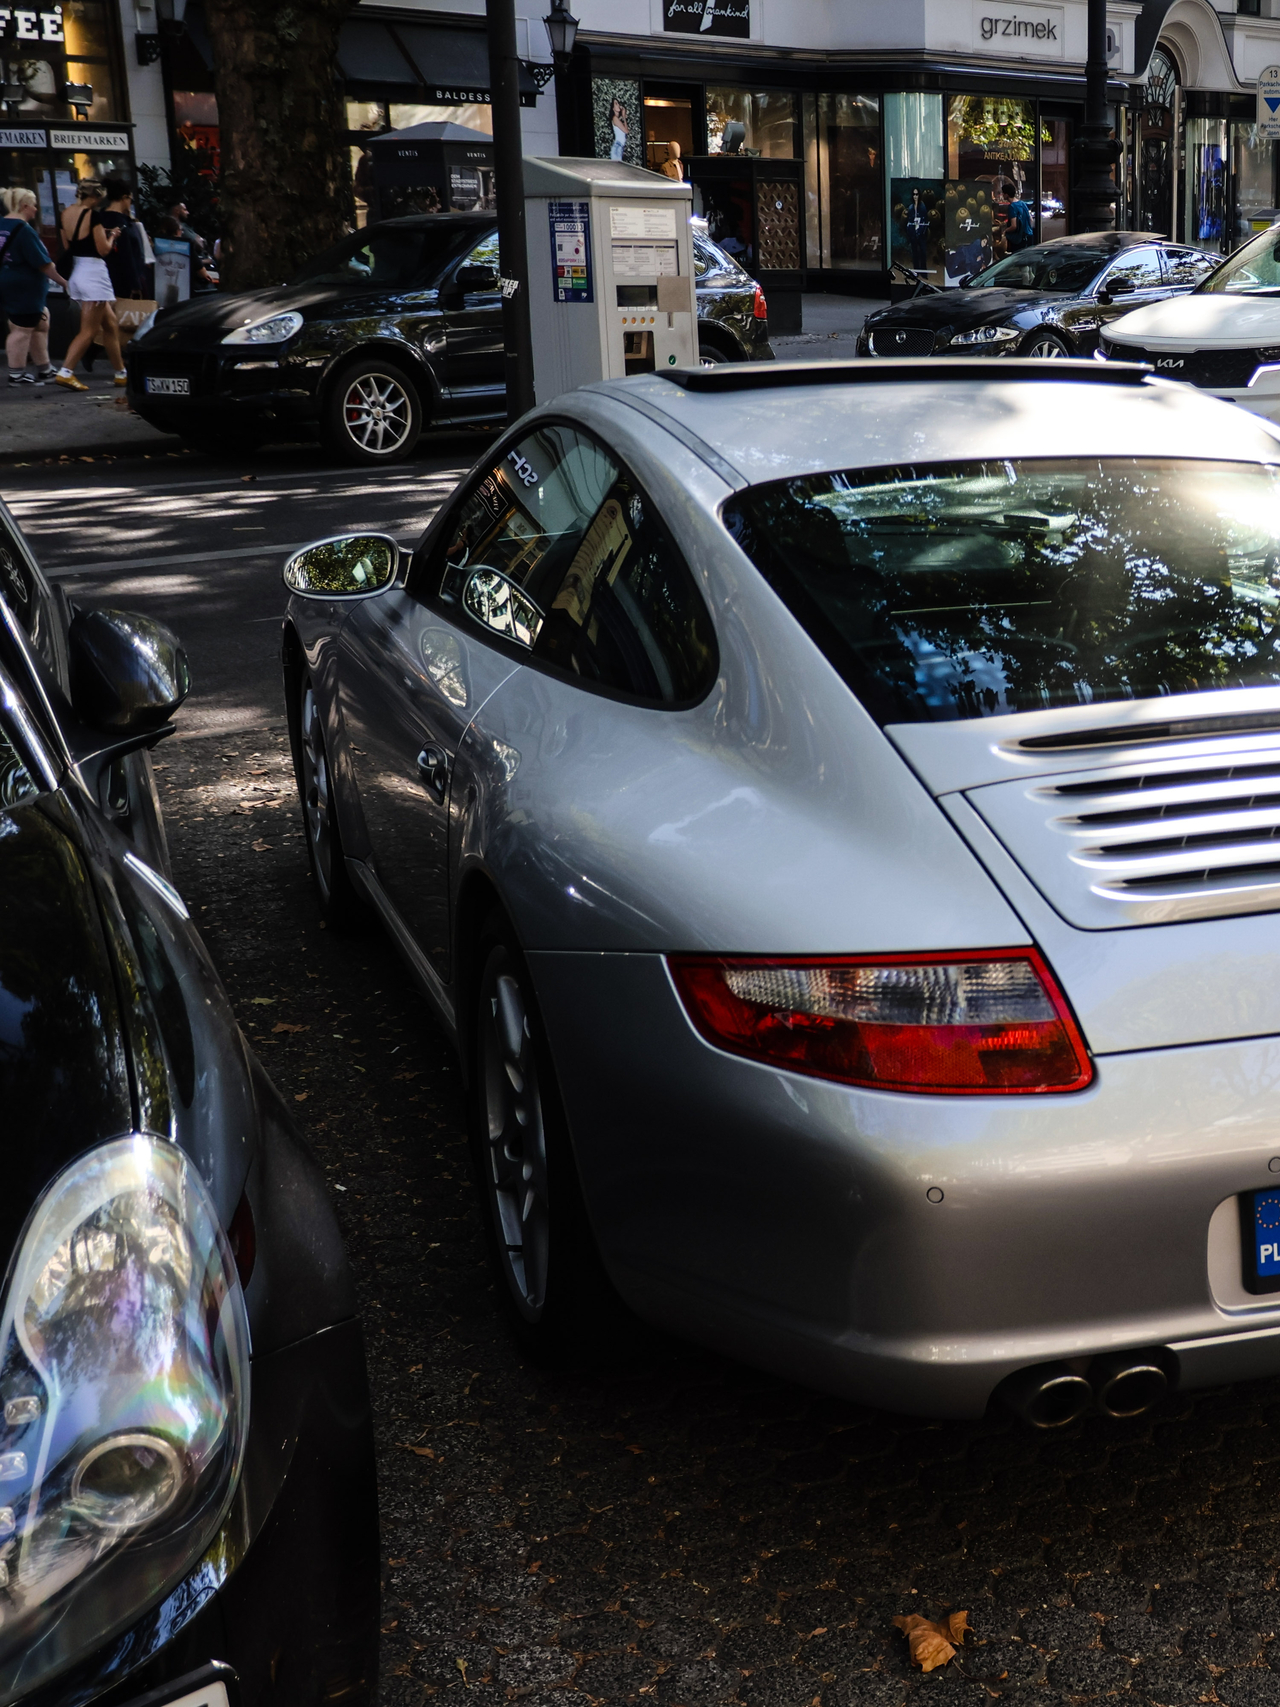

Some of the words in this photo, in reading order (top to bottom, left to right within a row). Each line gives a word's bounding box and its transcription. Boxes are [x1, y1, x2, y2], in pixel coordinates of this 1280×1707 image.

[668, 0, 686, 17] for
[688, 2, 703, 14] all
[706, 3, 749, 19] mankind
[981, 15, 1057, 40] grzimek
[1269, 69, 1278, 79] 13
[54, 134, 126, 146] BRIEFMARKEN
[1157, 359, 1184, 368] KIA
[171, 380, 189, 393] 150
